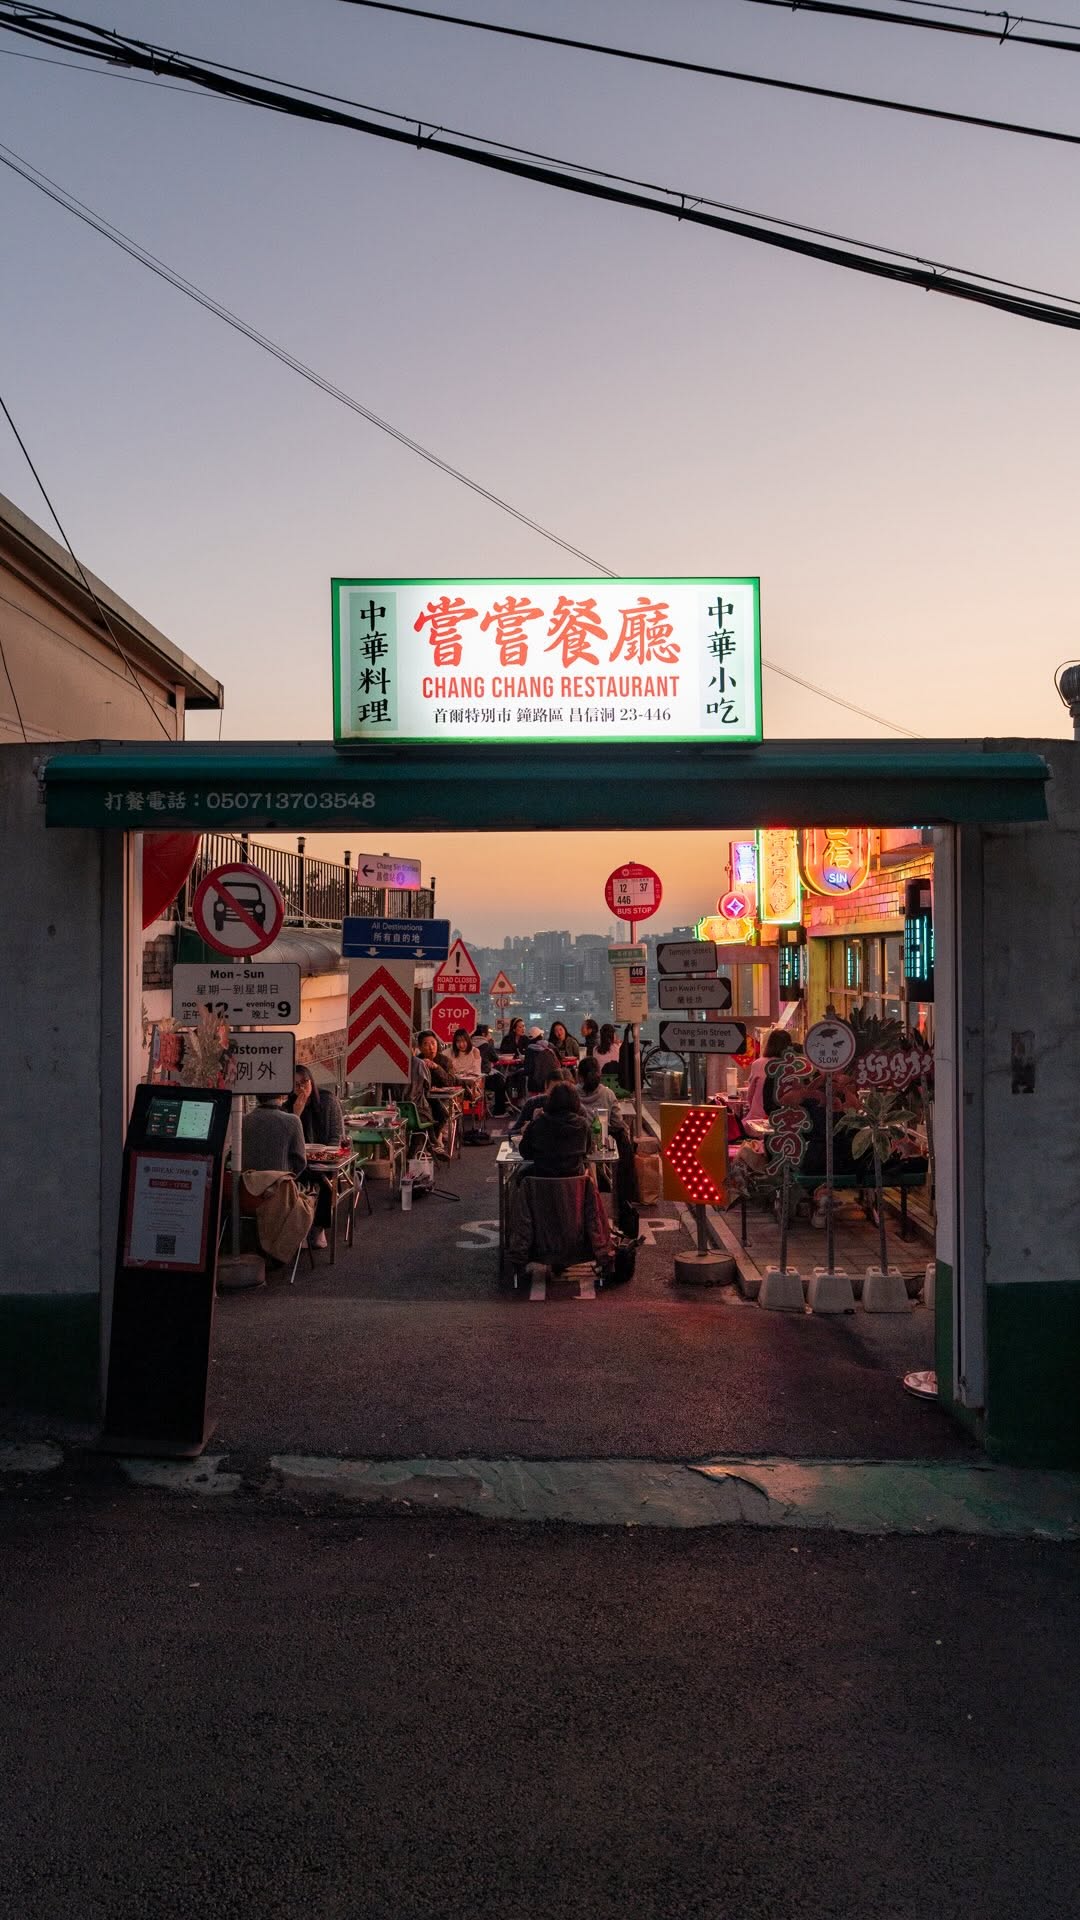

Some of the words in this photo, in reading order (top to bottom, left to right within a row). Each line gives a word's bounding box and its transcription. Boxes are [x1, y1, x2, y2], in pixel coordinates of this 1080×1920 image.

[413, 595, 681, 669] 嘗嘗餐廳
[358, 600, 391, 725] 中華料理
[706, 596, 739, 725] 中華小吃
[422, 677, 485, 699] CHANG
[492, 676, 554, 698] CHANG
[561, 675, 680, 698] RESTAURANT
[433, 707, 511, 724] 首爾特別市
[569, 707, 616, 723] 昌信洞
[619, 707, 671, 721] 23-446
[828, 873, 847, 883] SIN
[619, 883, 628, 893] 12
[639, 883, 648, 892] 37
[617, 895, 631, 905] 446
[371, 922, 381, 930] All
[382, 922, 423, 932] Destinations
[210, 969, 234, 979] Mon
[243, 969, 265, 979] Sun
[196, 984, 279, 995] 星期一到星期日
[678, 984, 696, 992] Kwai
[697, 984, 715, 993] Fong
[246, 1000, 275, 1009] evening
[277, 1001, 291, 1018] 9
[438, 1008, 470, 1018] STOP
[182, 1010, 200, 1020] 正午
[252, 1010, 270, 1020] 晚上
[672, 1027, 696, 1038] Chang
[697, 1028, 708, 1036] Sin
[709, 1028, 731, 1037] Street
[232, 1044, 283, 1055] ustomer
[818, 1056, 840, 1064] SLOW
